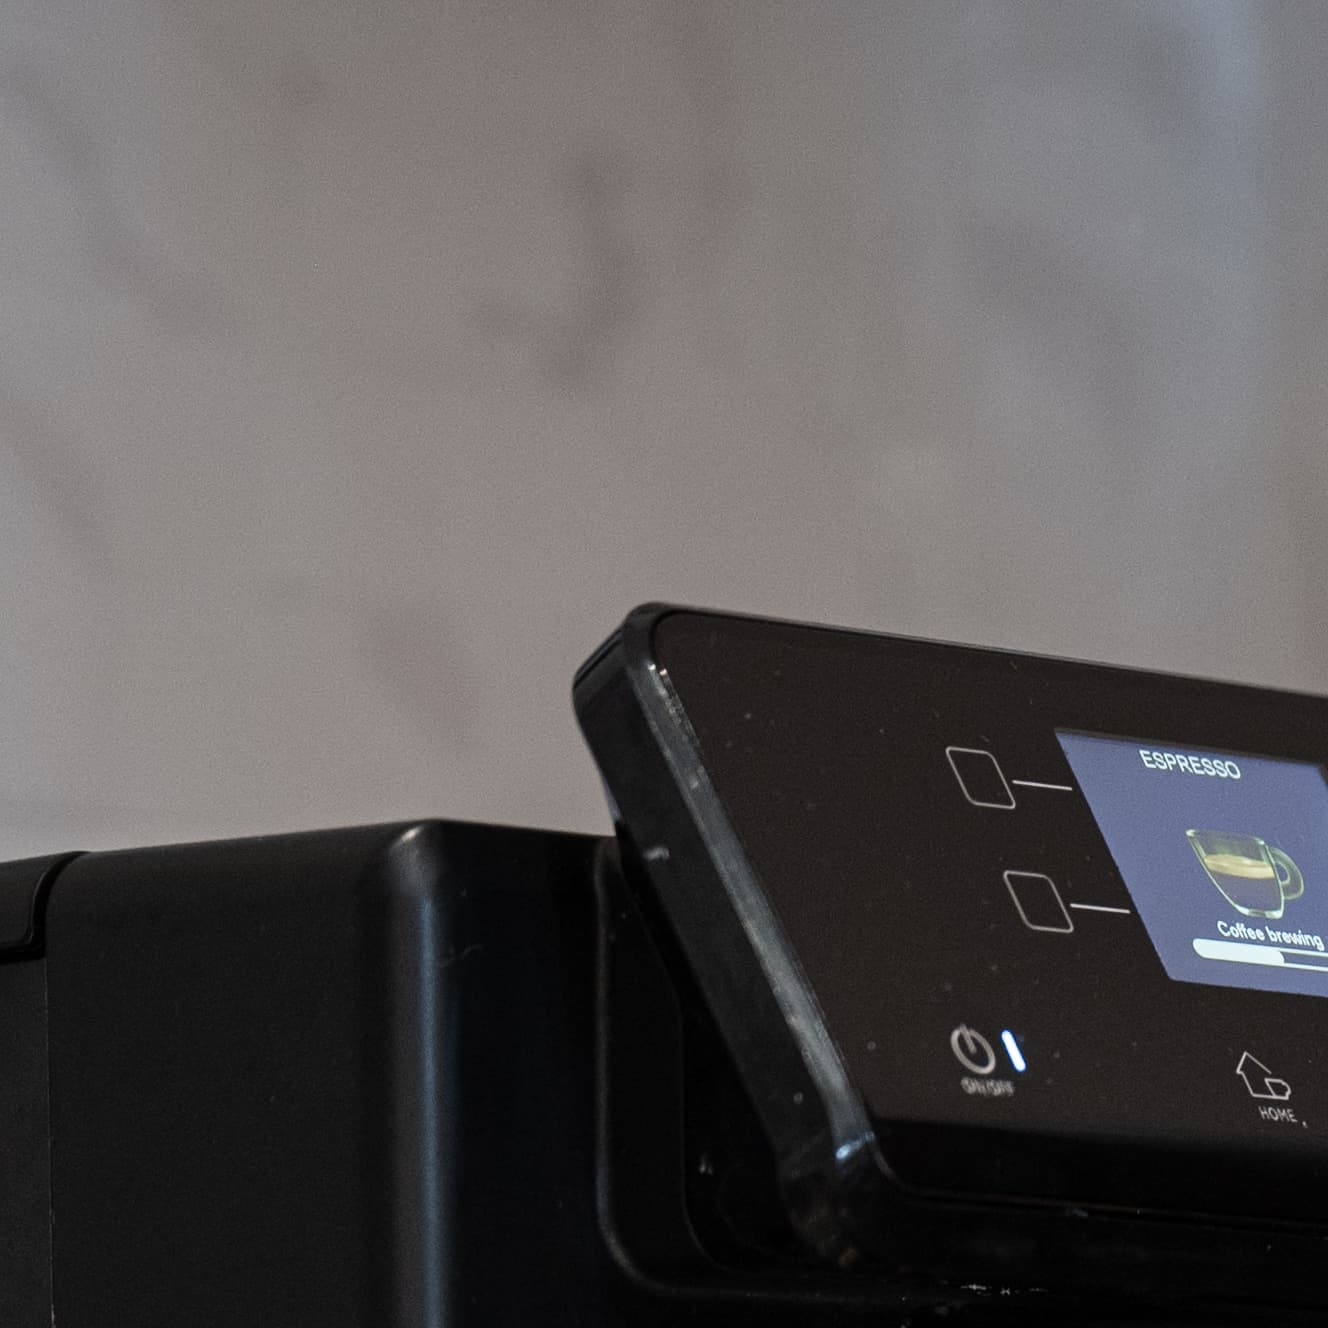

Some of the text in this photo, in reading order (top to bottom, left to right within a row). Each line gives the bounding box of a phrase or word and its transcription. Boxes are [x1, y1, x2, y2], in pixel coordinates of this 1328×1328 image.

[1139, 749, 1241, 779] ESPRESSO
[1217, 920, 1325, 951] Coffee brewing
[1258, 1106, 1298, 1123] HOME
